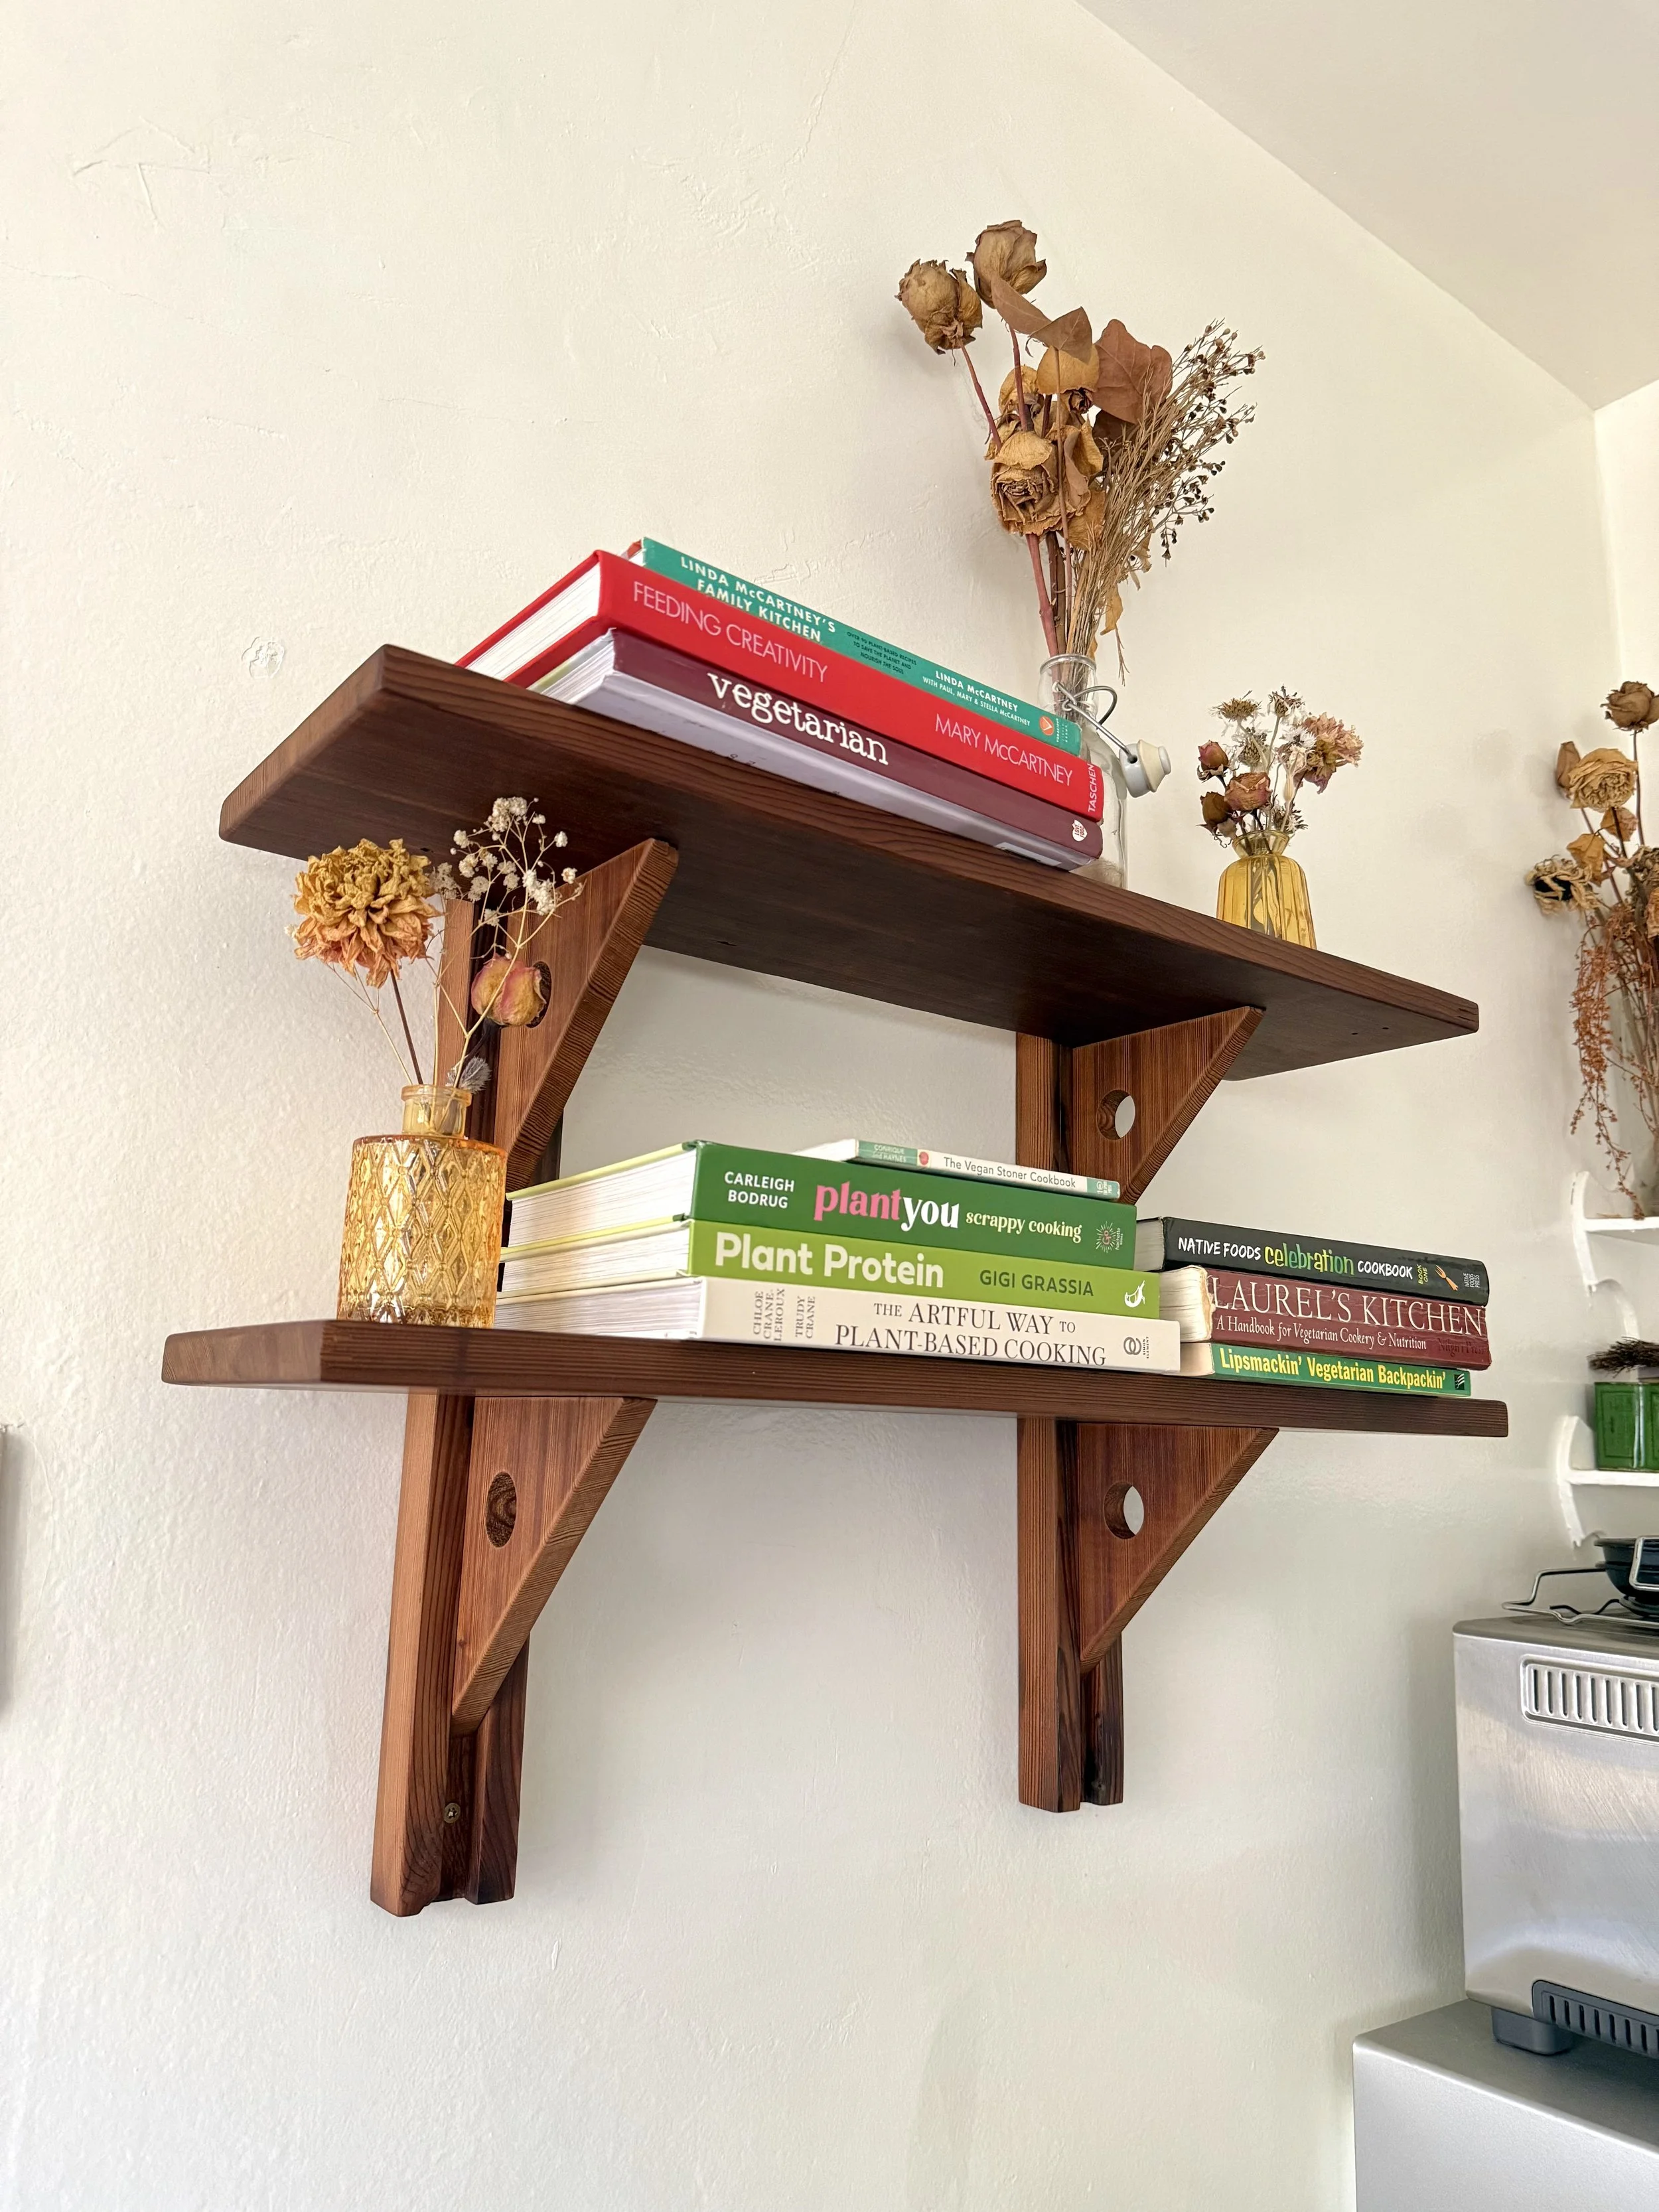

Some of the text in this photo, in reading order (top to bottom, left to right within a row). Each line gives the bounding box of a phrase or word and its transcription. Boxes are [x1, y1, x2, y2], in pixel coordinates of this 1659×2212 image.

[682, 556, 835, 632] LINDA McCARTNEY'S
[697, 579, 822, 642] FAMILY KITCHEN
[633, 581, 828, 682] FEEDING CREATIVITY
[861, 644, 873, 653] SAVE
[883, 654, 900, 664] PLANET
[861, 652, 881, 665] NOURISH
[892, 666, 904, 674] SOUL
[899, 654, 917, 665] RECIPES
[922, 676, 938, 688] WITH
[939, 684, 955, 696] PAUL,
[956, 691, 972, 702] MARY
[980, 701, 998, 713] STELLA
[999, 709, 1030, 727] McCARTNEY
[936, 670, 1018, 712] LINDA McCARTNEY
[707, 672, 889, 765] vegetarian
[935, 713, 1073, 786] MARY McCARTNEY
[1087, 763, 1098, 812] TASCHEN
[883, 1154, 906, 1163] HAYNES
[944, 1157, 1076, 1188] The Vegan Stoner Cookbook
[725, 1171, 794, 1192] CARLEIGH
[728, 1189, 788, 1209] BODRUG
[814, 1181, 1082, 1243] plantyou scrappy cooking
[715, 1232, 944, 1288] Plant Protein
[1178, 1237, 1413, 1280] NATIVE FOODS celebration COOKBOOK
[979, 1270, 1094, 1296] GIGI GRASSIA
[753, 1291, 763, 1335] CHLOE
[774, 1289, 784, 1341] LEROUX
[795, 1295, 805, 1337] TRUDY
[806, 1296, 816, 1339] CRANE
[874, 1303, 1075, 1335] THE ARTFUL WAY TO
[1210, 1277, 1482, 1337] LAUREL'S KITCHEN
[835, 1324, 1106, 1366] PLANT-BASED COOKING
[1216, 1315, 1427, 1351] A Handbook for Vegetarian Cookery & Nutrition
[1220, 1347, 1446, 1390] Lipsmackin' Vegetarian Backpackin'
